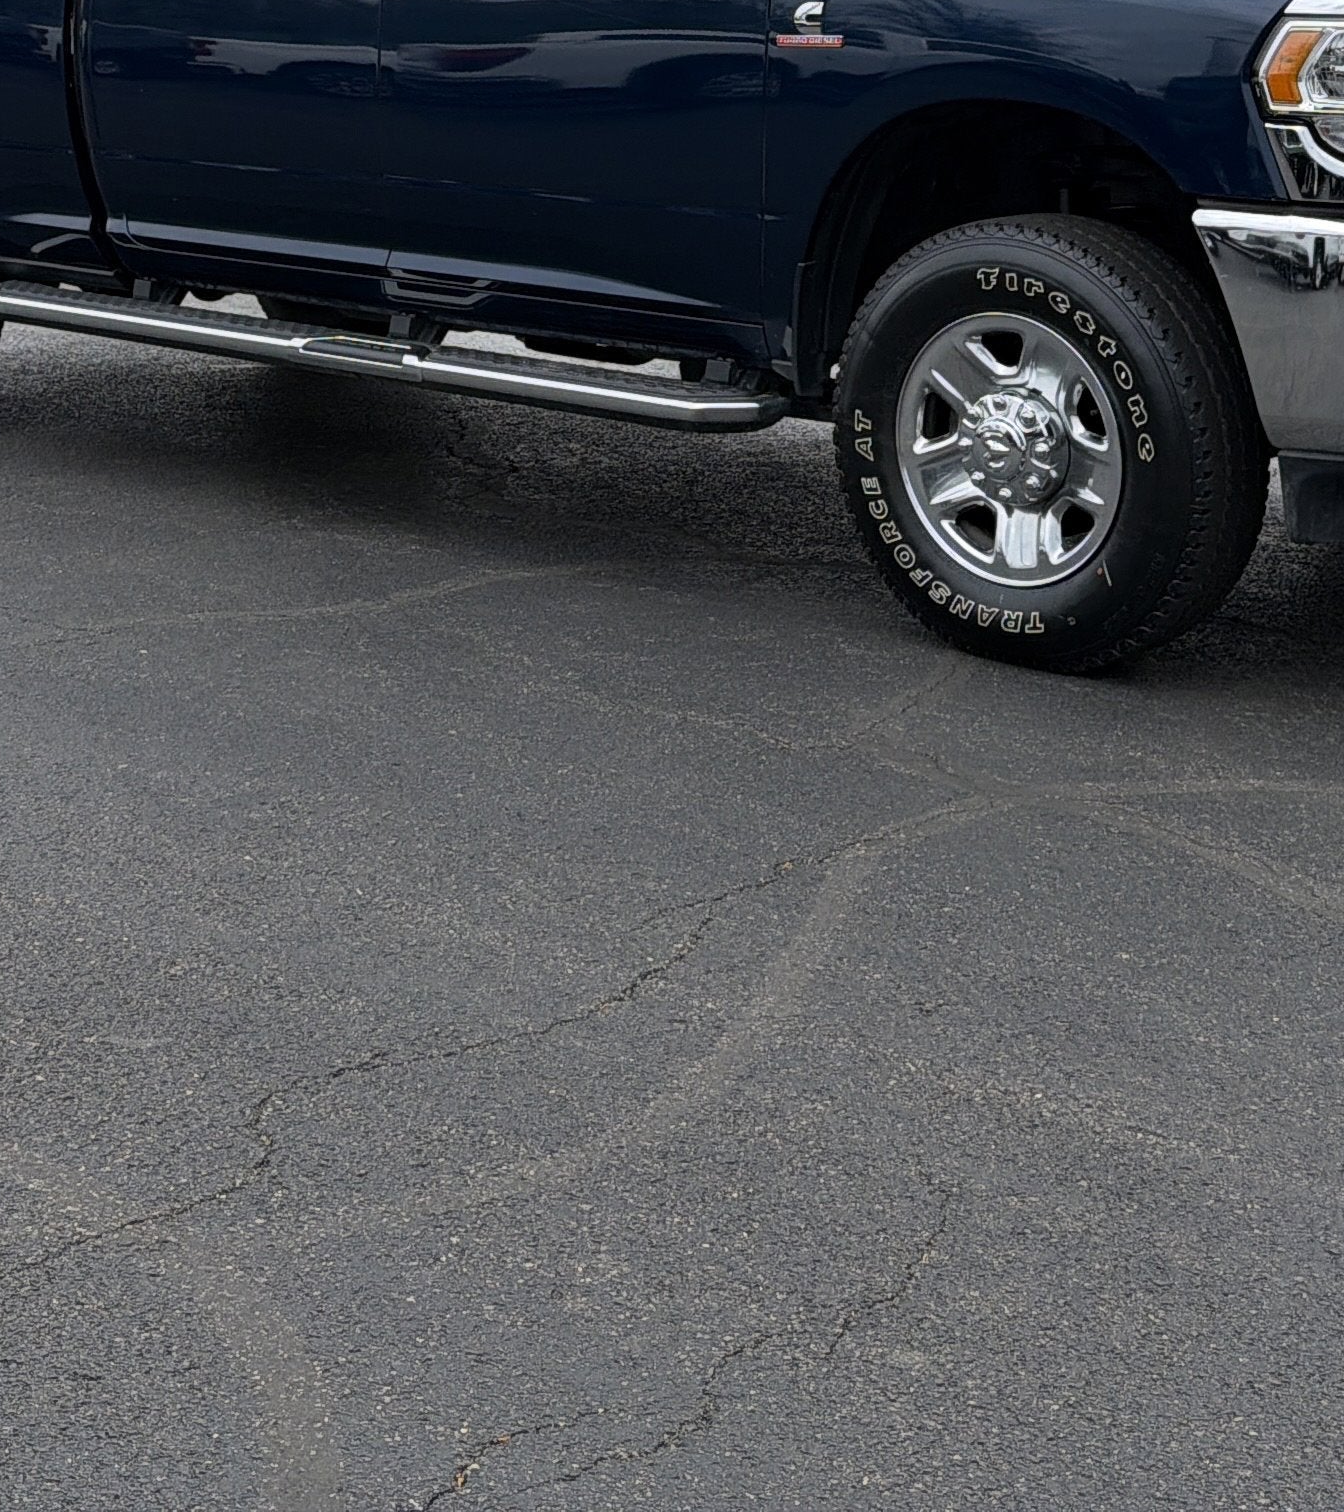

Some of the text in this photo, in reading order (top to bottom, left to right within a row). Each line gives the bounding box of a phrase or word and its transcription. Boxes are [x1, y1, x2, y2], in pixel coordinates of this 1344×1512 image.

[976, 267, 1155, 464] Firestone
[853, 409, 1044, 634] TRANSFORCE AT
